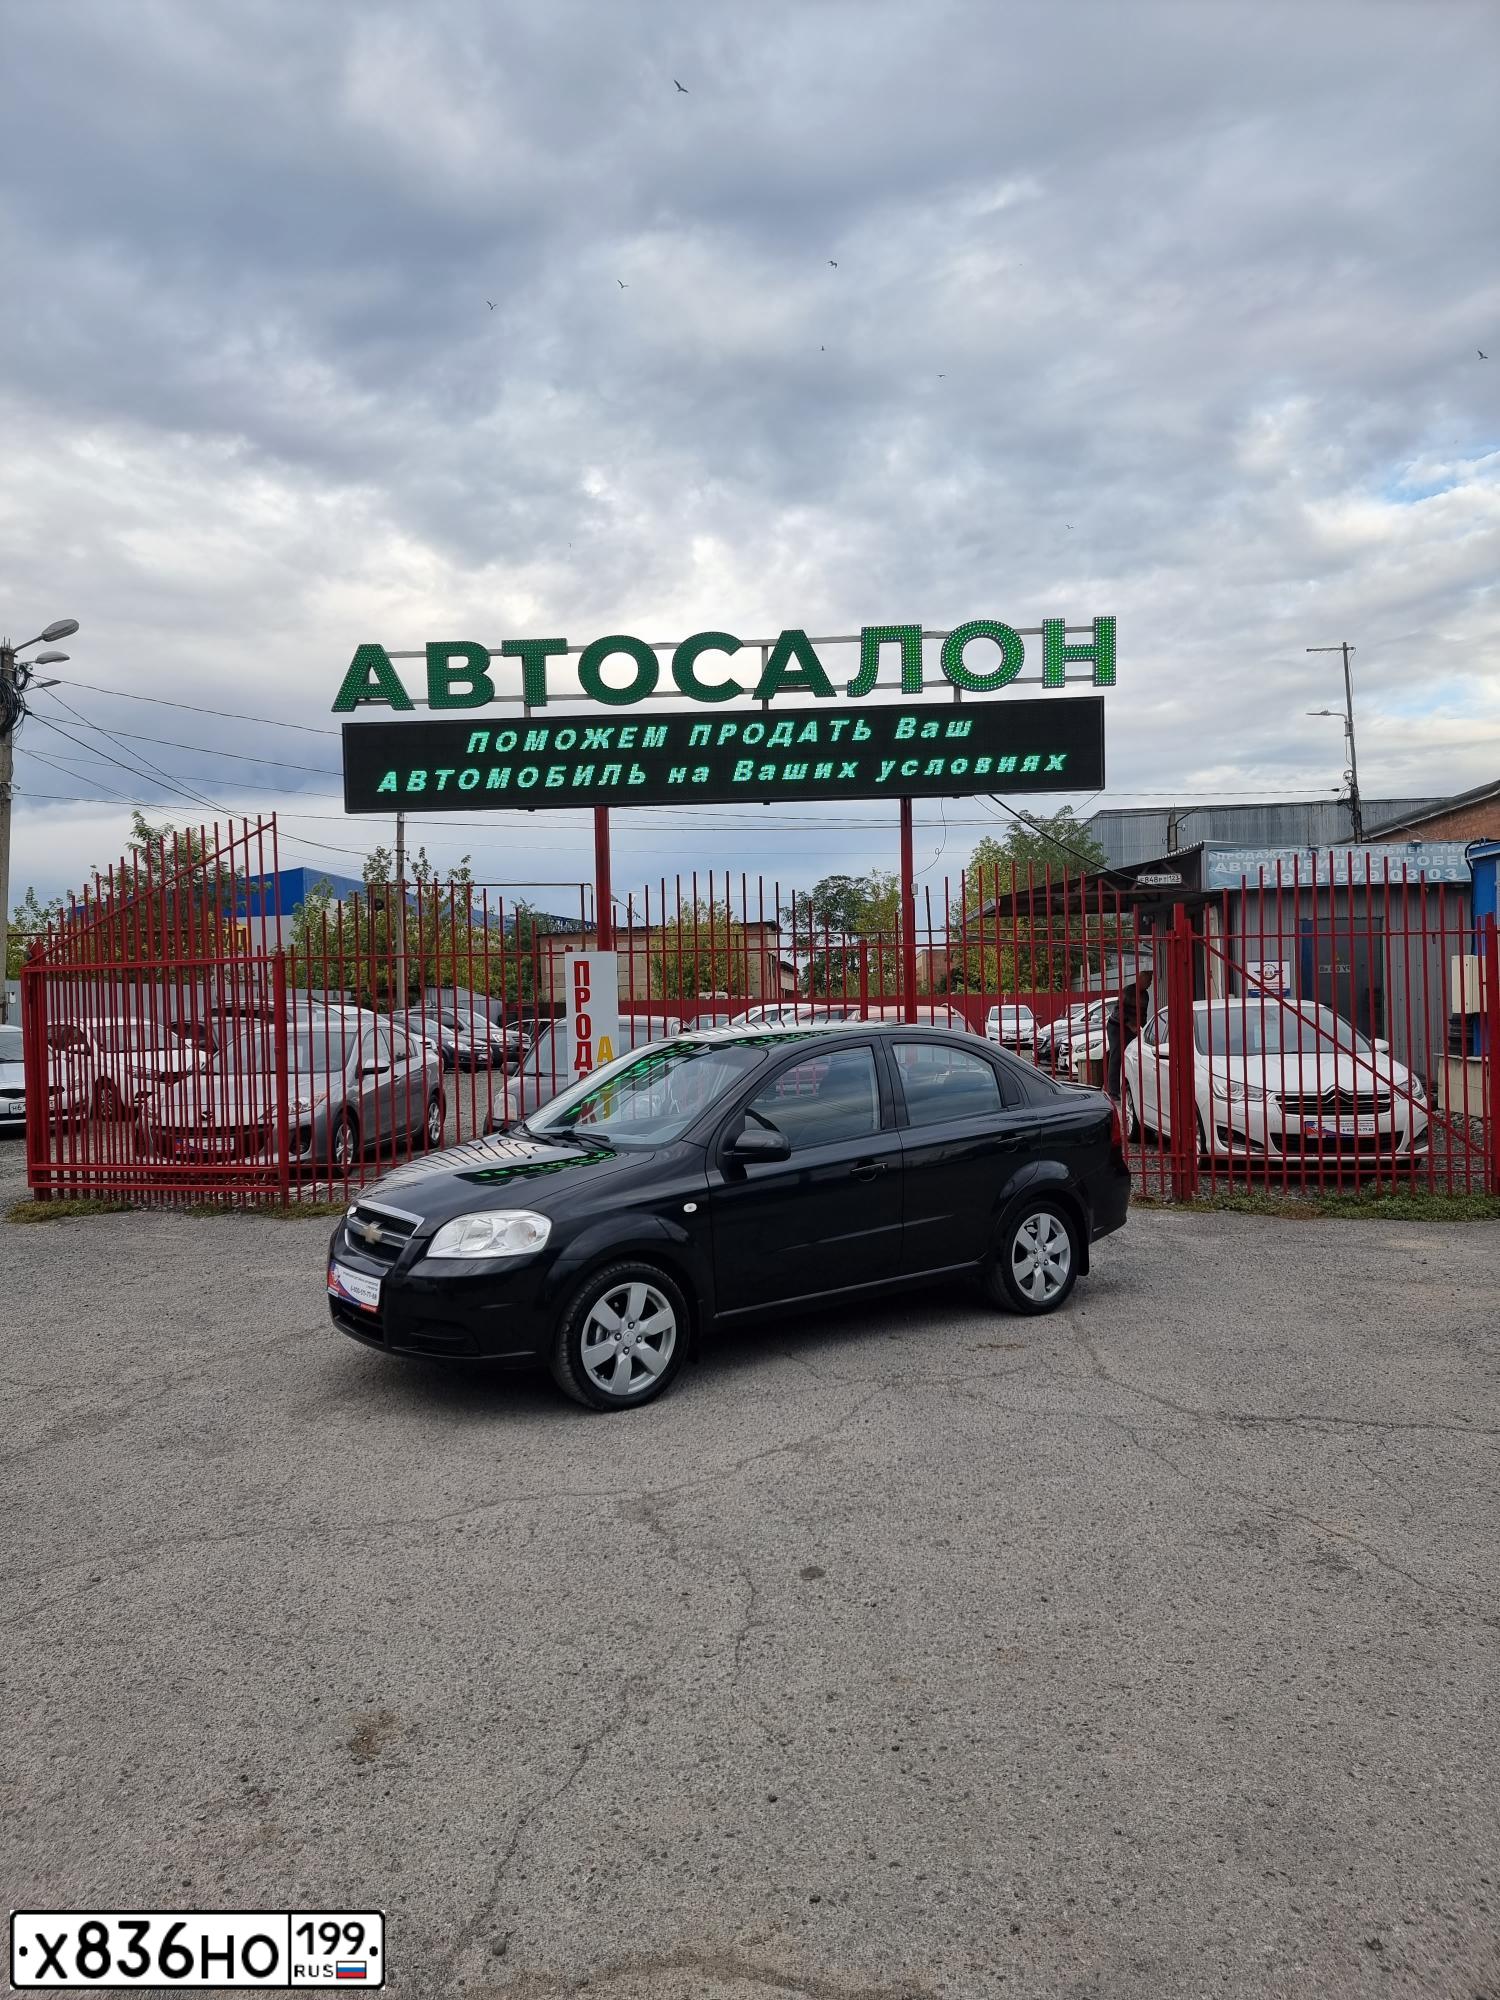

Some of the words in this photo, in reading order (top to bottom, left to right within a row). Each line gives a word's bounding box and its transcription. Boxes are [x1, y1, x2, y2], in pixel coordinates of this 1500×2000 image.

[331, 615, 1117, 712] АВТОСАЛОН
[467, 726, 669, 753] ПОМОЖЕМ
[688, 719, 872, 748] ПРОДАТЬ
[895, 717, 973, 740] Ваш
[378, 763, 647, 793] АВТОМОБИЛЬ
[668, 766, 710, 784] на
[732, 759, 858, 782] Ваших
[875, 754, 1067, 783] условиях
[1428, 868, 1458, 880] 03
